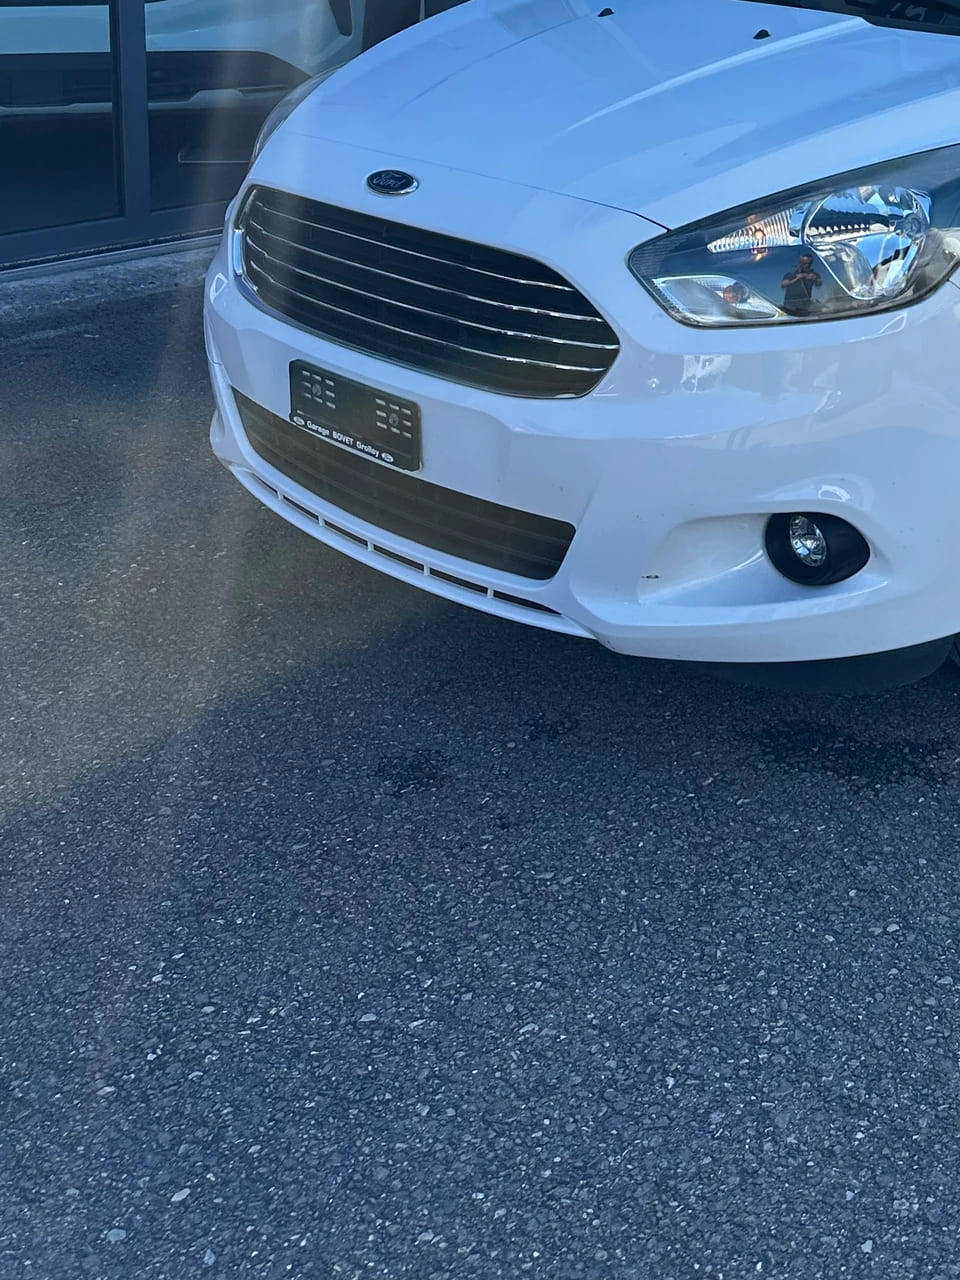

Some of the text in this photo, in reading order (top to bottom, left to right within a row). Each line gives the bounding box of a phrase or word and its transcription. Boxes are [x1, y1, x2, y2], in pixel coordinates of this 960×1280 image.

[373, 171, 406, 188] Ford
[306, 420, 329, 436] Garage
[333, 431, 354, 446] BOVET
[356, 441, 380, 457] Grolley
